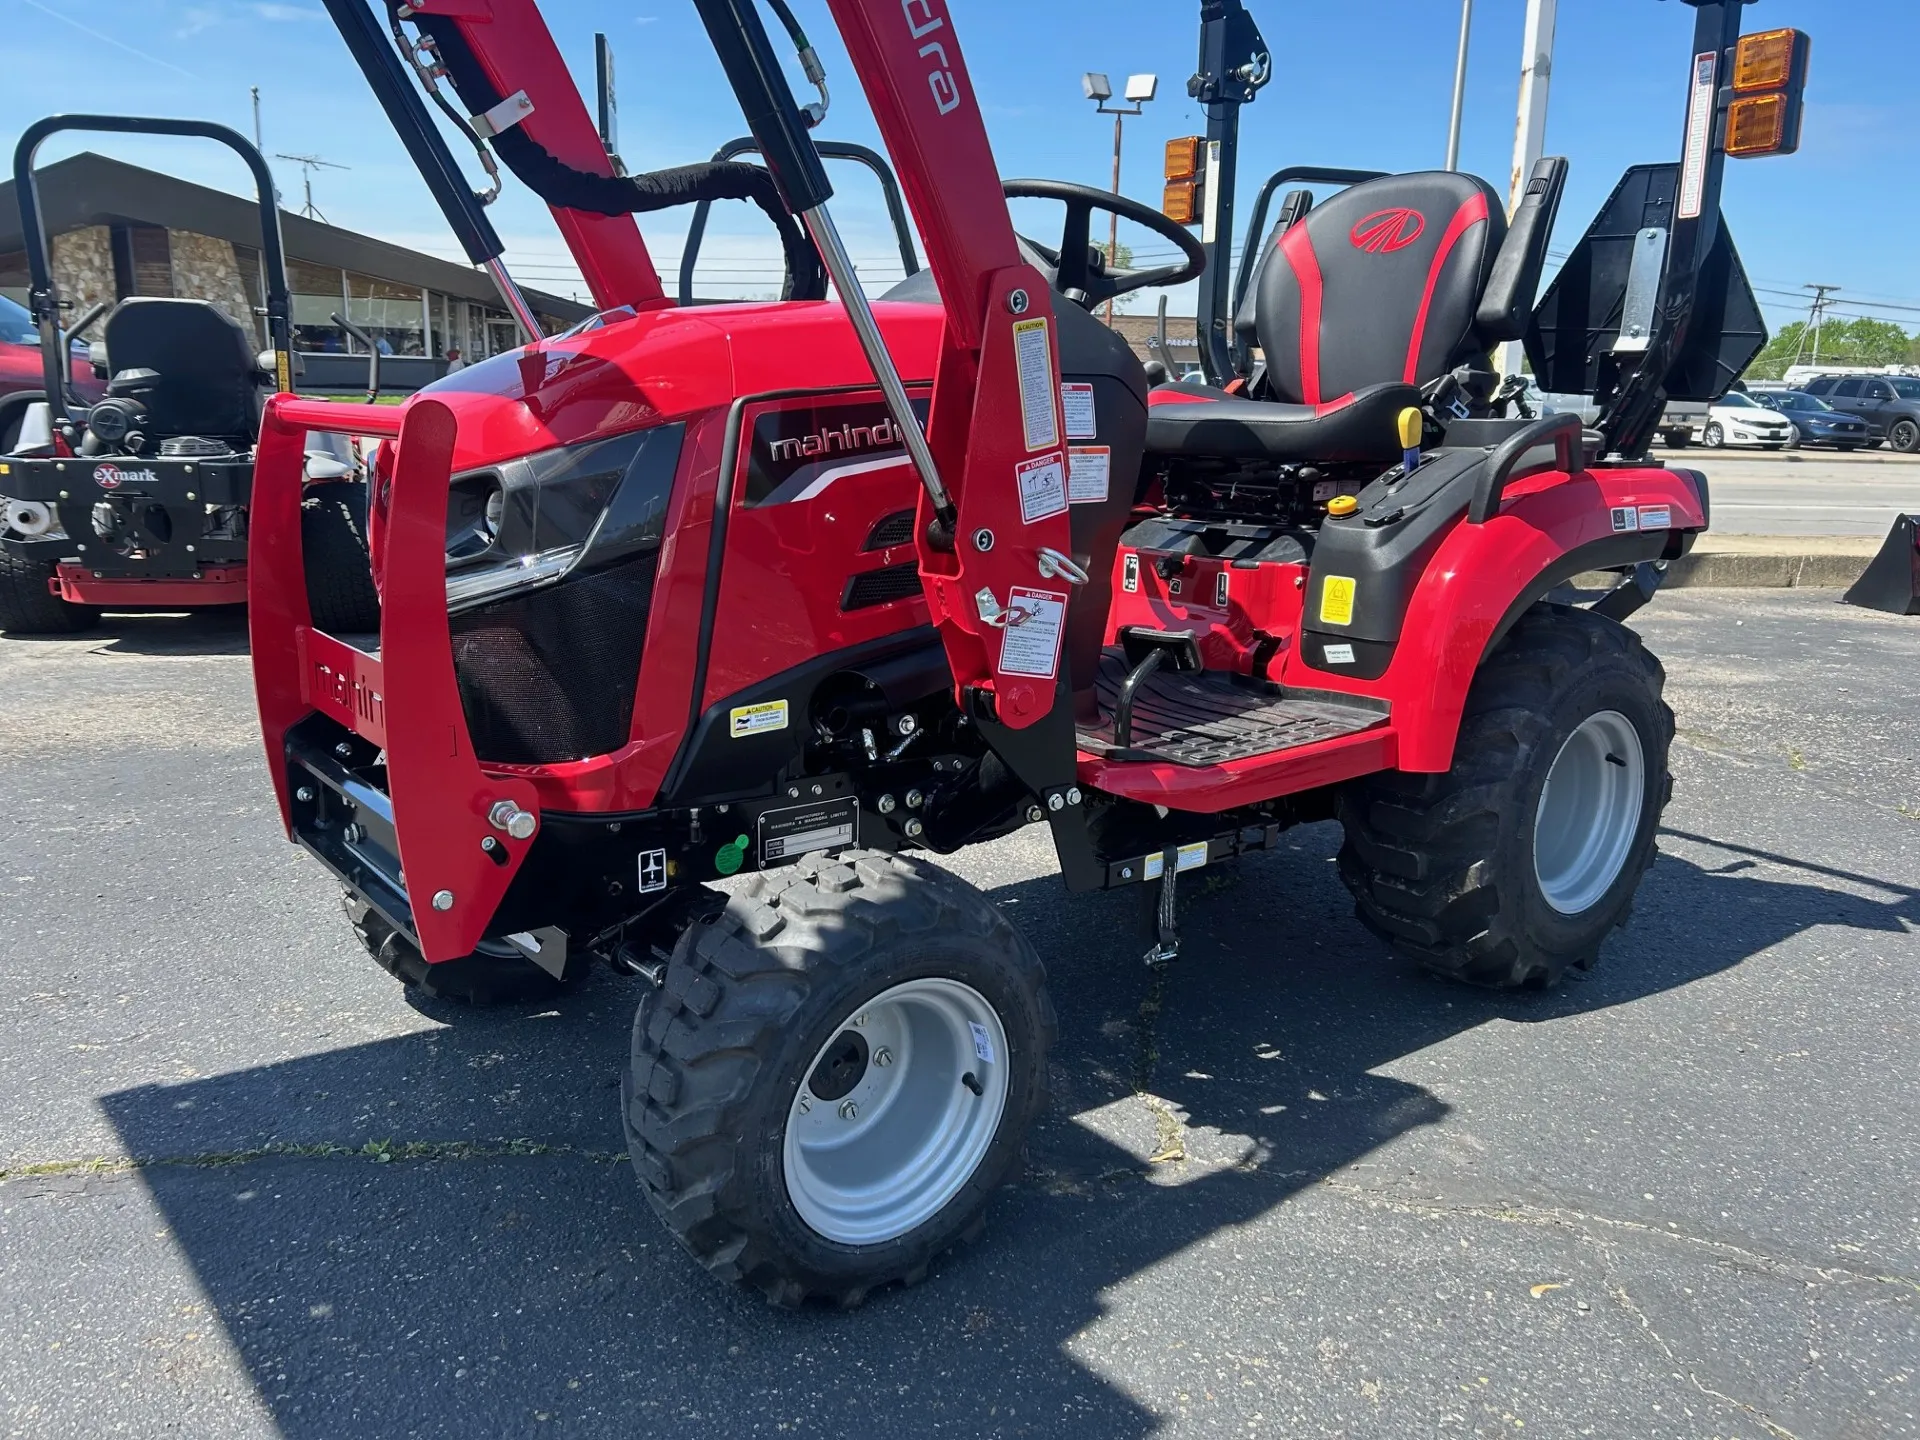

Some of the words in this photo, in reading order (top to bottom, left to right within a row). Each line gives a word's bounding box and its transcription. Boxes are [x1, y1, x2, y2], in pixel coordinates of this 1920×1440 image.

[1022, 321, 1043, 330] CAUTION
[1030, 457, 1055, 468] DANGER
[1031, 592, 1053, 600] DANGER
[752, 705, 773, 713] CAUTION
